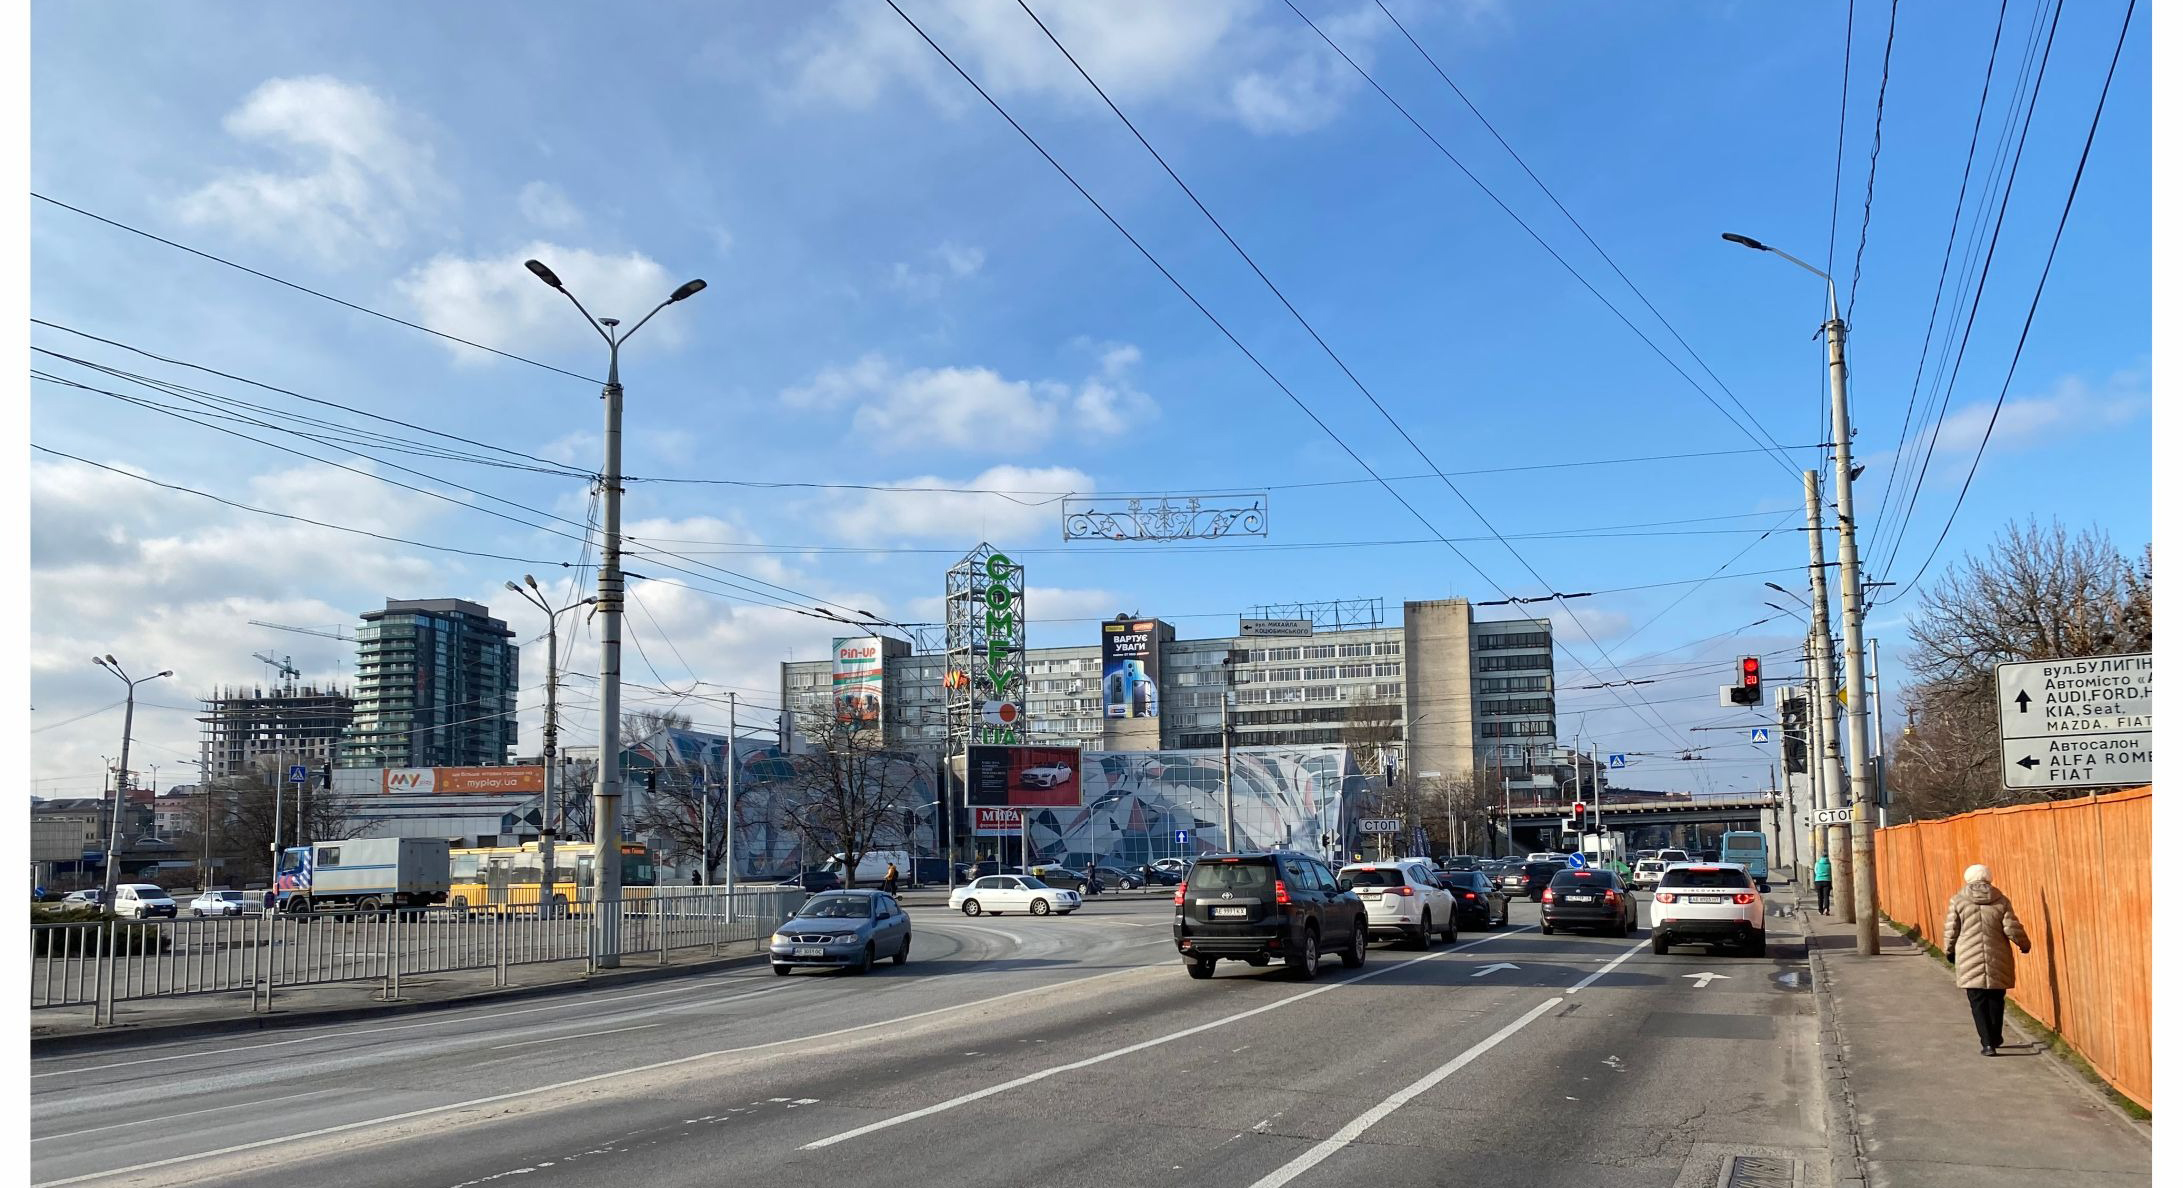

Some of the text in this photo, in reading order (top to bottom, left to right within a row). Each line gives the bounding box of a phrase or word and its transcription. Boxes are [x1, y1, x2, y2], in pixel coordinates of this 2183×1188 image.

[985, 554, 1014, 695] COMFY
[1113, 634, 1148, 643] ВАРТУЄ
[1115, 643, 1146, 652] УВАГИ
[1746, 675, 1757, 685] 20
[2045, 675, 2130, 690] Автомісто
[2117, 716, 2152, 727] FIAT
[2049, 740, 2139, 752] Автосалон
[2050, 754, 2096, 766] ALFA
[2050, 768, 2093, 781] FIAT
[467, 778, 518, 788] myplay.ua
[982, 810, 1020, 821] МИРА
[1365, 821, 1396, 830] СТОП
